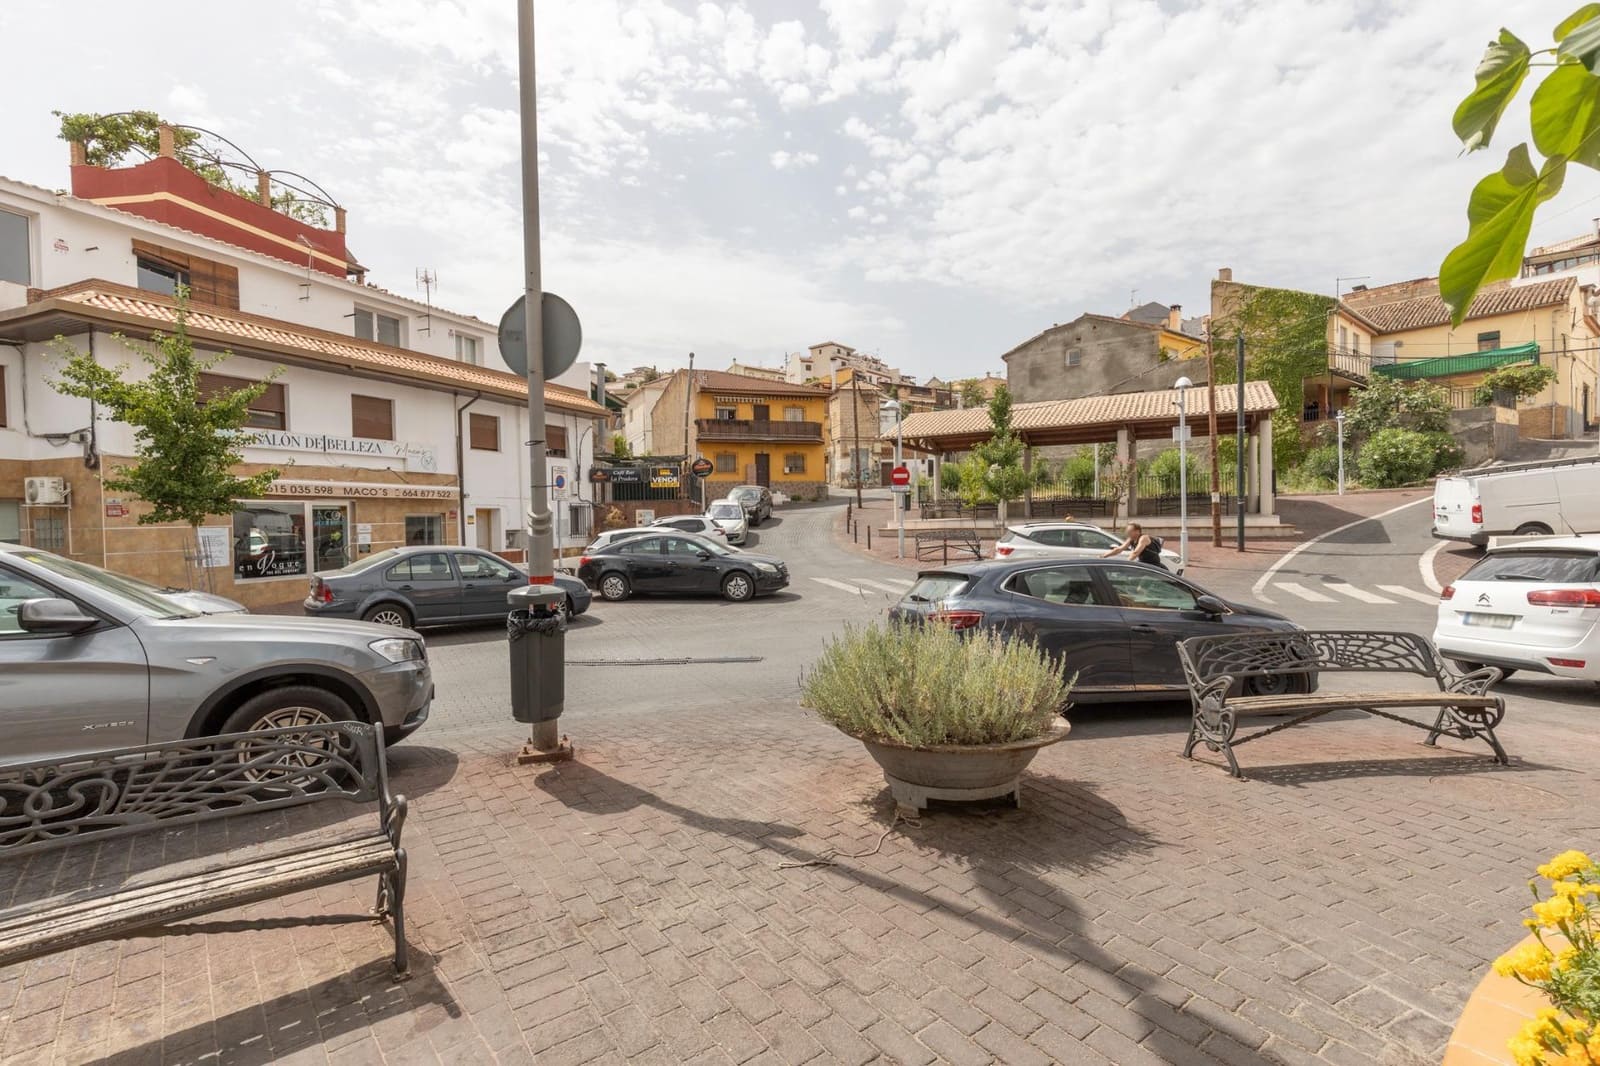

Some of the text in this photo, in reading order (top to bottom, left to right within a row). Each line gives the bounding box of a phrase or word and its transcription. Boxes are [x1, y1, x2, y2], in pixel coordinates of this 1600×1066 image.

[253, 432, 382, 454] SALÓN DE BELLEZA
[290, 485, 311, 494] 035
[314, 486, 333, 495] 598
[402, 489, 418, 497] 664
[437, 490, 451, 498] 522
[239, 563, 253, 572] en
